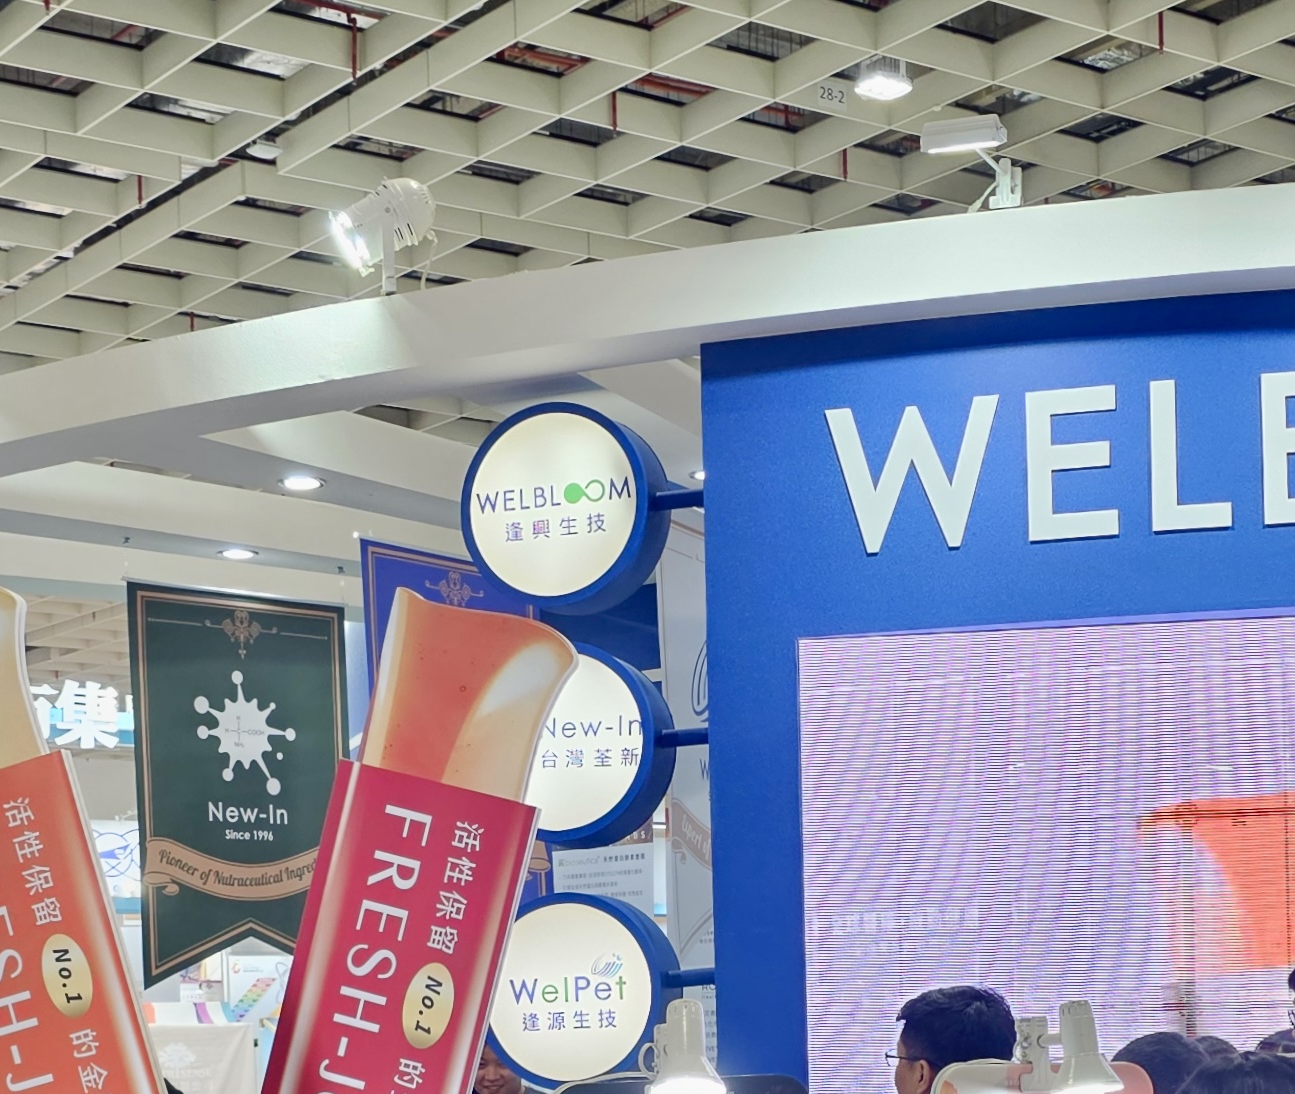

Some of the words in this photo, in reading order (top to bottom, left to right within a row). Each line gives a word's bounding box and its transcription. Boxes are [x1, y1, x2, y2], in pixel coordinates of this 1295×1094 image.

[819, 86, 846, 104] 28-2
[208, 801, 288, 825] New-In
[225, 829, 251, 841] Since
[253, 830, 274, 841] 1996
[158, 849, 200, 876] Pioneer
[200, 868, 212, 886] of
[213, 869, 284, 887] Nutraceutical
[2, 796, 63, 926] 活性保留
[51, 946, 84, 1005] No.1
[427, 820, 485, 955] 活性保留
[414, 974, 445, 1037] No.1
[509, 974, 628, 1007] WelPet
[521, 1007, 619, 1034] 逢源生技
